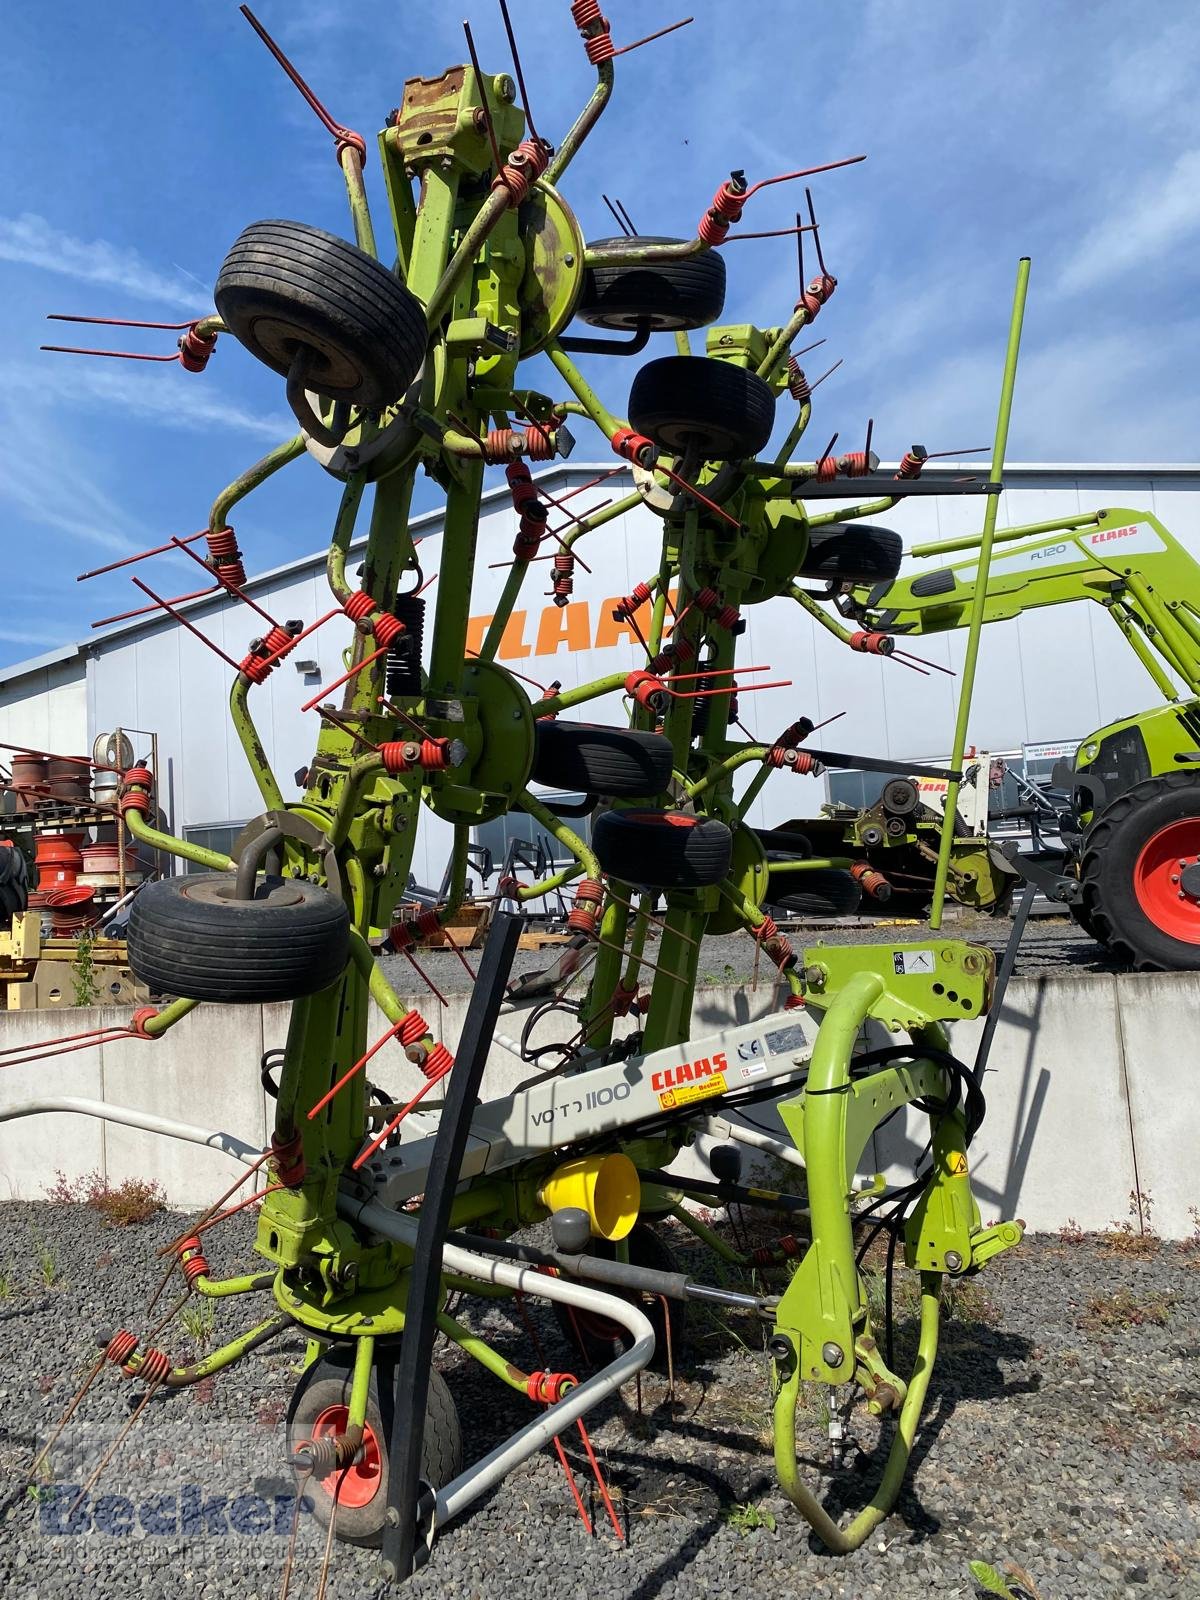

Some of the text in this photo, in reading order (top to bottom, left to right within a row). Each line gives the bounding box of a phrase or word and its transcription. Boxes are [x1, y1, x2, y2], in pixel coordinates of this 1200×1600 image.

[1091, 526, 1138, 544] CLAAS
[651, 1053, 728, 1091] CLAAS
[585, 1082, 631, 1110] 1100
